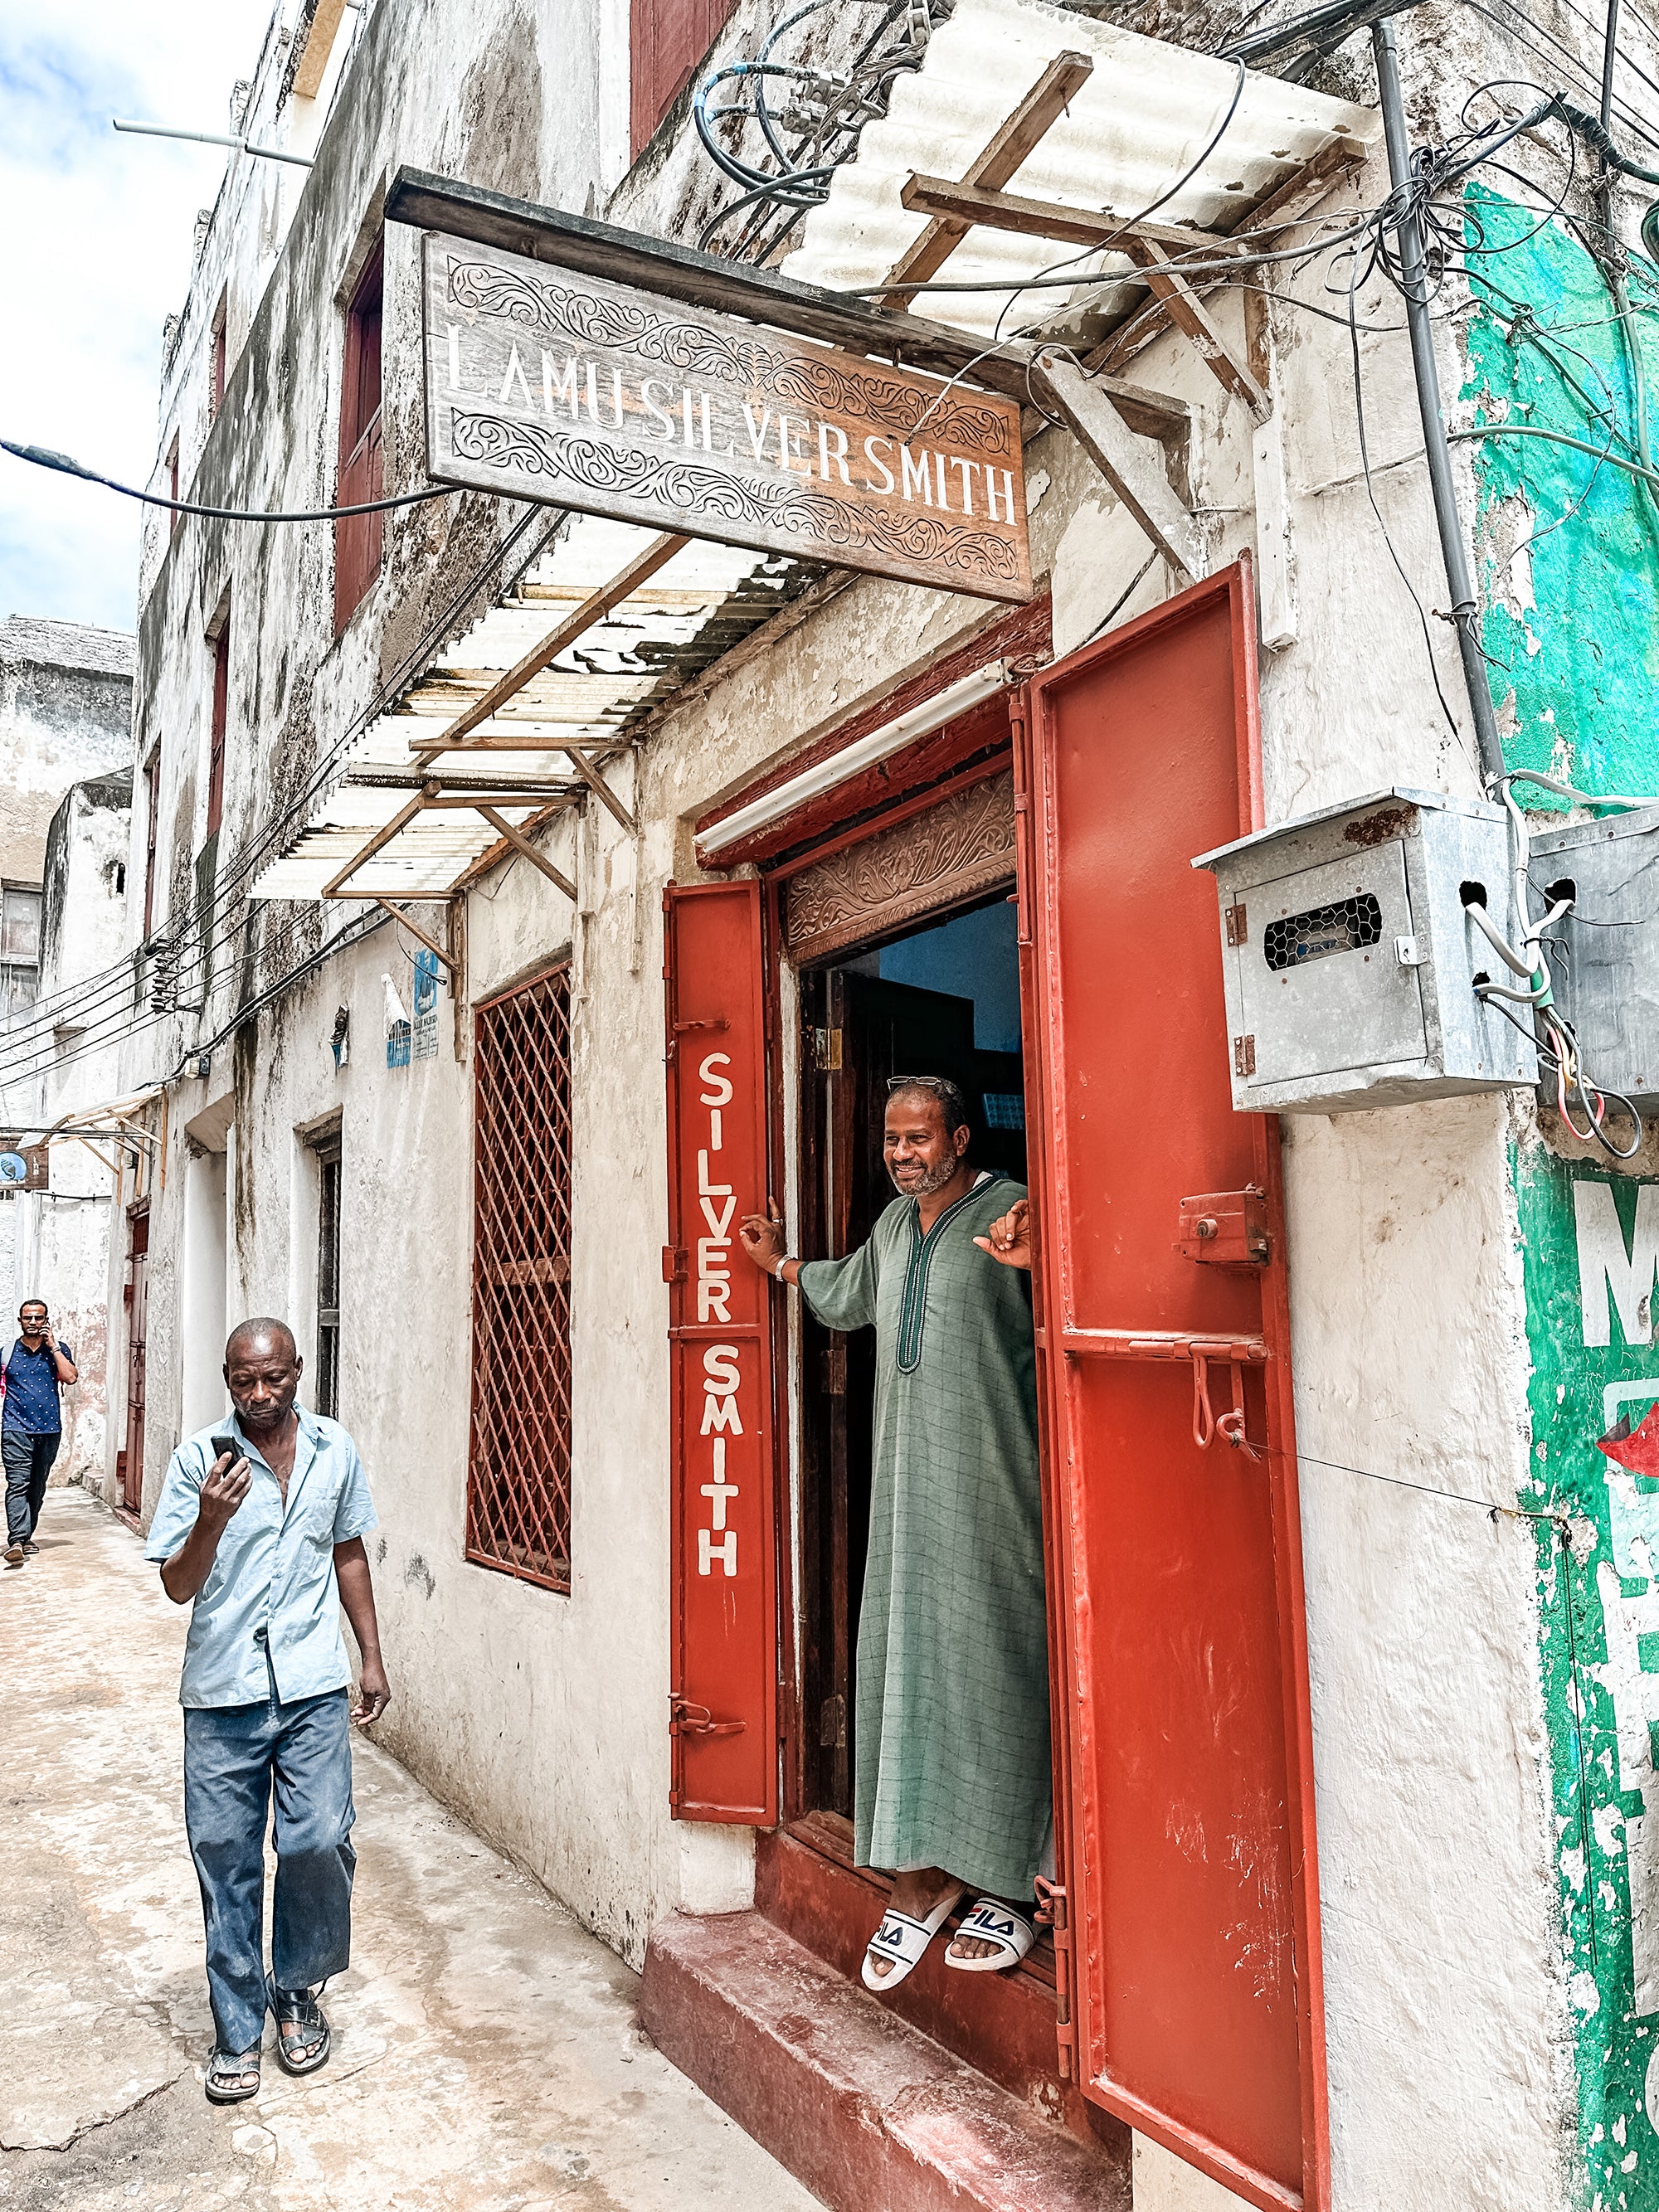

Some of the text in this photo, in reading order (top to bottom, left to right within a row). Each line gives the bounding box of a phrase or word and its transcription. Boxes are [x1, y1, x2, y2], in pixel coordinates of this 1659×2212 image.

[446, 322, 626, 430] LAMU
[697, 1052, 744, 1578] SILVER SMITH
